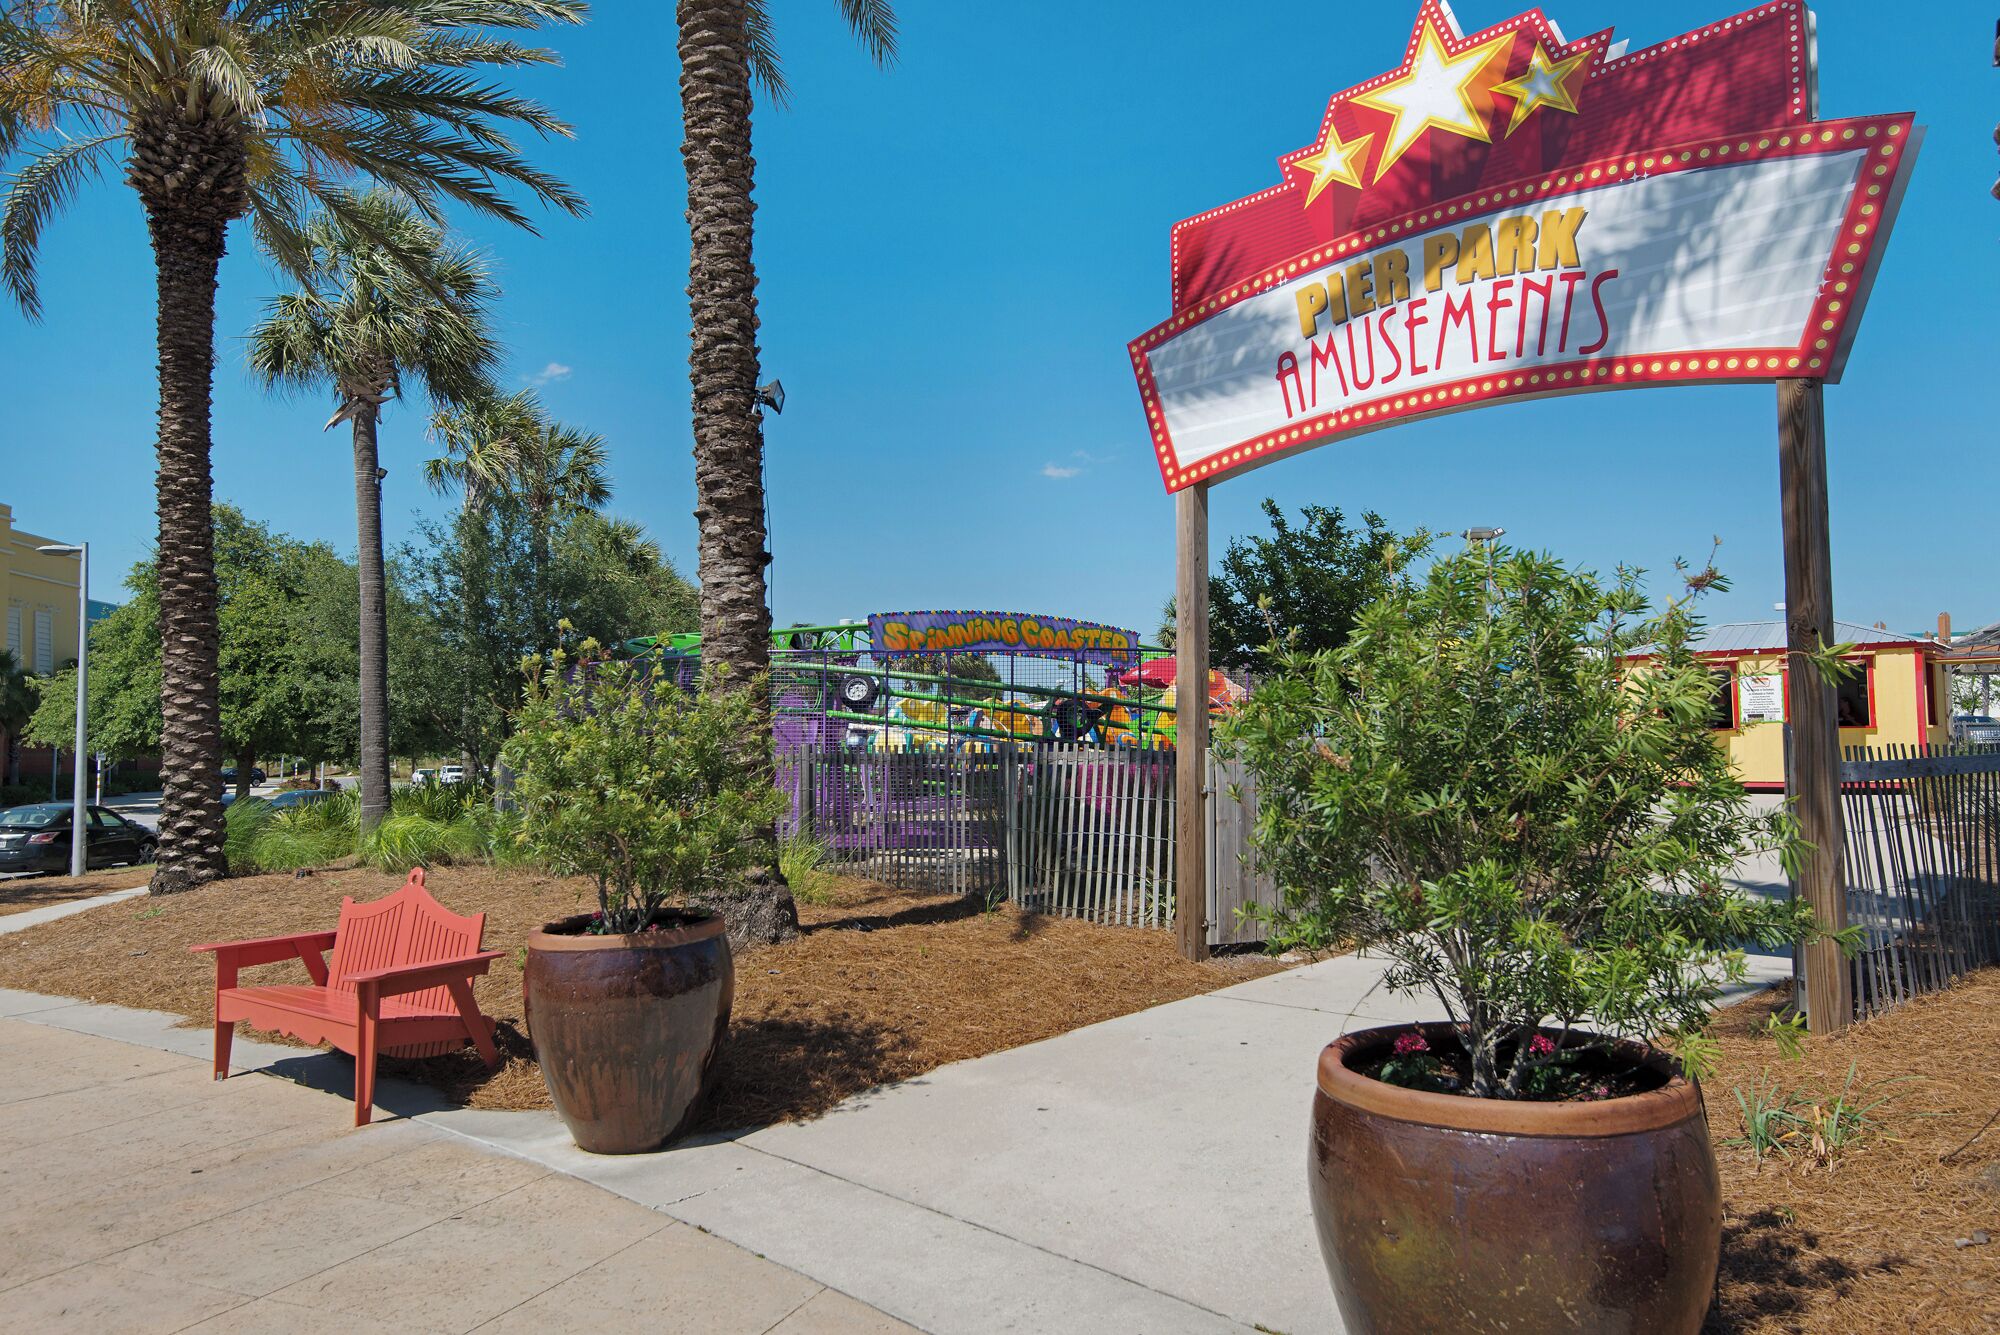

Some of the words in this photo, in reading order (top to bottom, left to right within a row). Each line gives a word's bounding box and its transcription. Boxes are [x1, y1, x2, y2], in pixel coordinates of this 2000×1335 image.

[1295, 247, 1410, 339] PIER
[1423, 206, 1589, 293] PARK
[1275, 269, 1619, 419] AMUSEMENTS
[1020, 618, 1130, 662] COASTER
